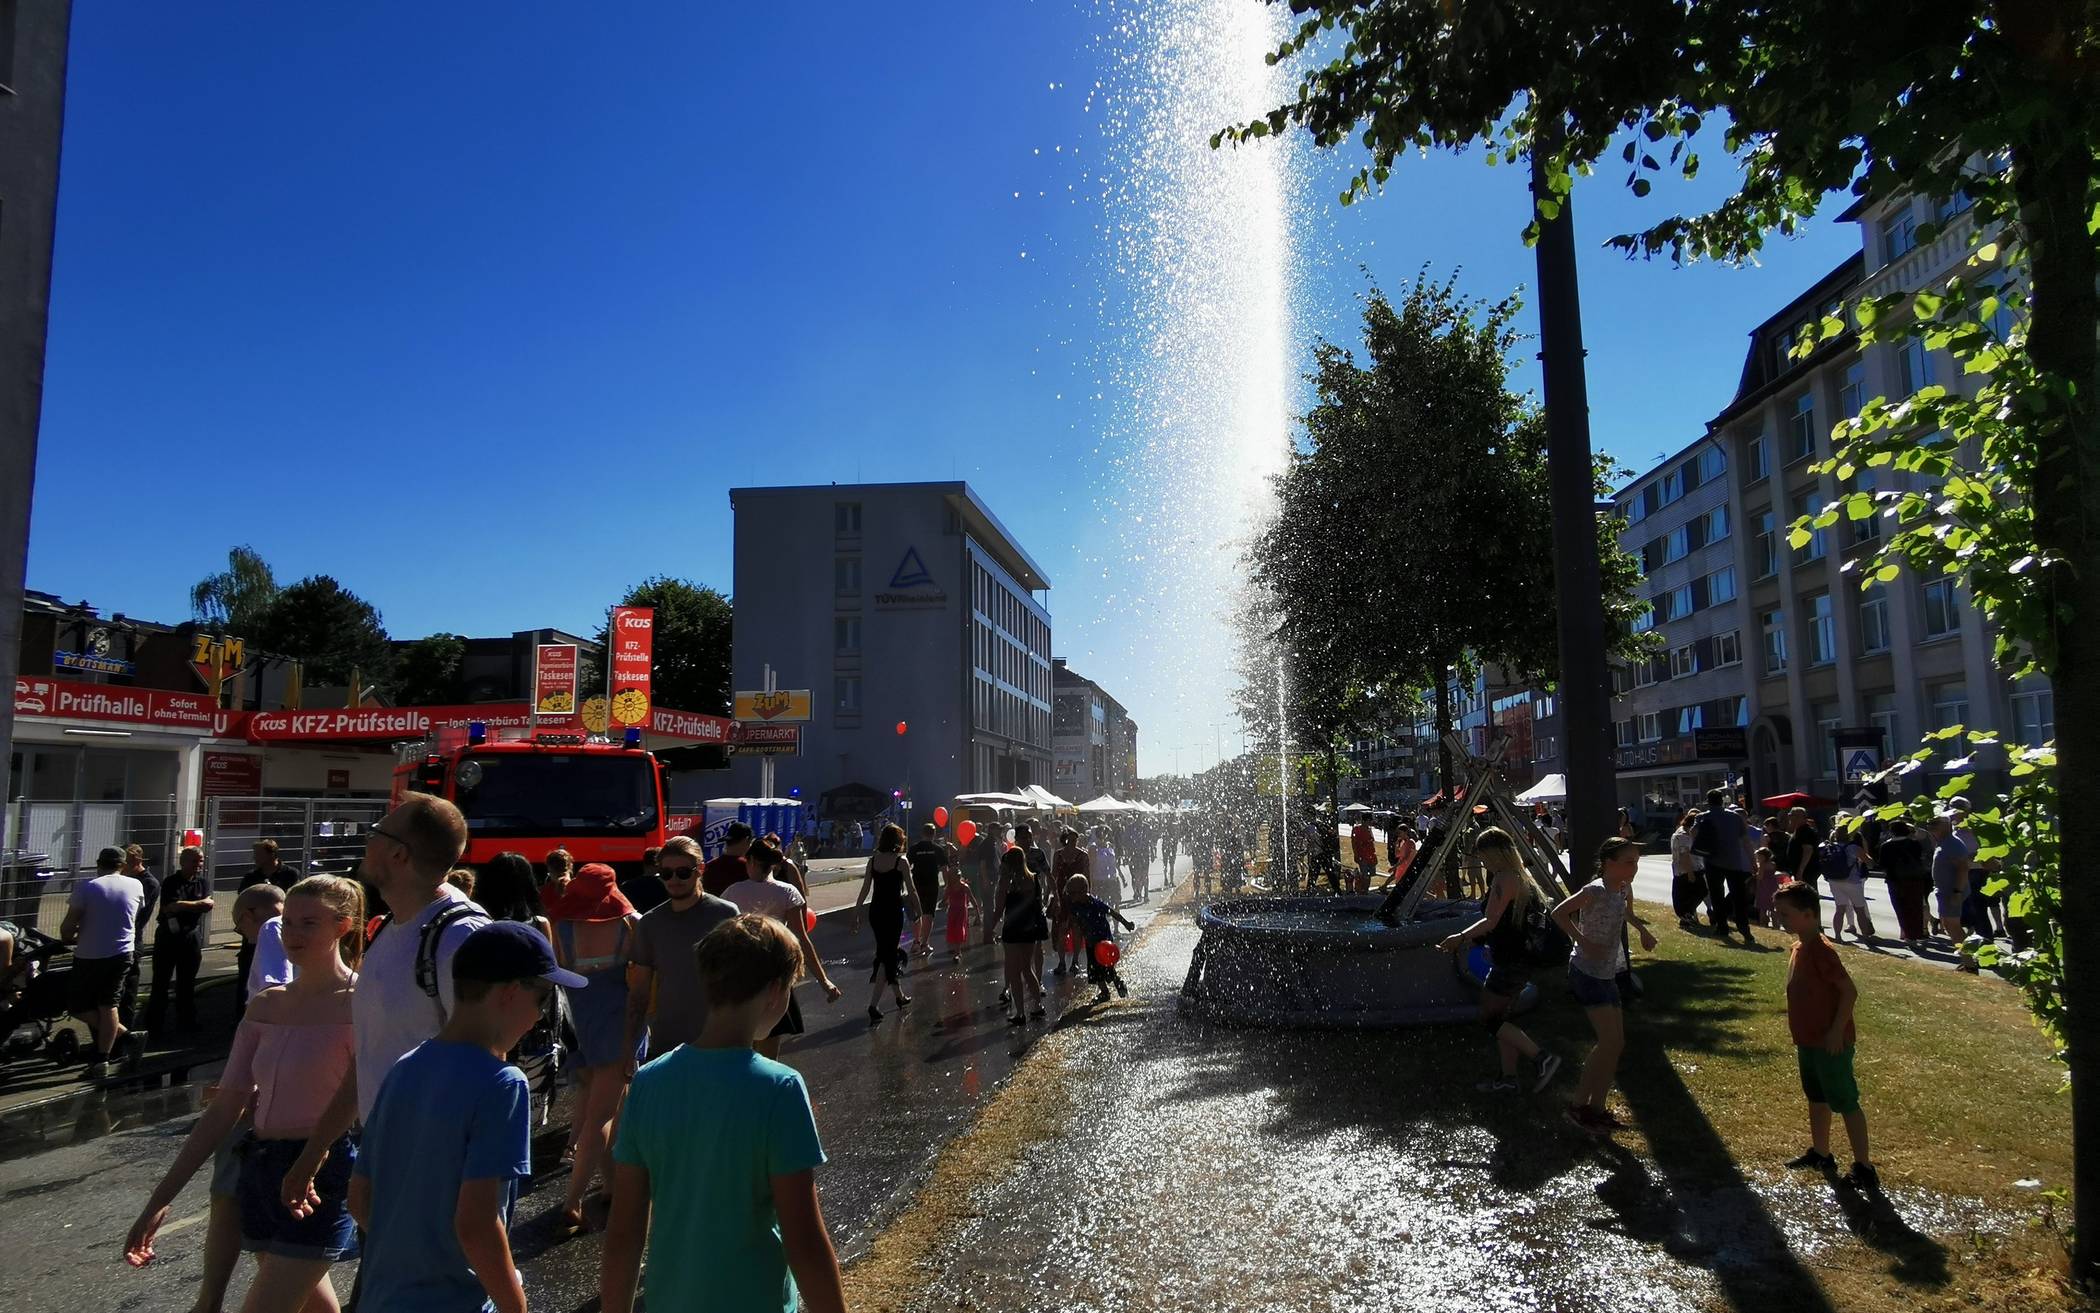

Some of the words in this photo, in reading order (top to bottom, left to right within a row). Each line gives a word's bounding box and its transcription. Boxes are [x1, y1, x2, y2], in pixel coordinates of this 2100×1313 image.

[194, 633, 245, 669] ZM
[616, 652, 649, 662] Prüfstelle
[59, 692, 144, 717] Prüfhalle
[169, 698, 198, 709] Sofort
[154, 709, 177, 720] ohne
[179, 711, 211, 722] Termin!
[291, 711, 430, 734] KFZ-Prüfstelle
[520, 714, 566, 726] Takesen
[653, 711, 721, 739] KFZ-Prüfstelle
[1615, 746, 1657, 767] AUTOHAUS
[668, 817, 692, 832] Unfall?
